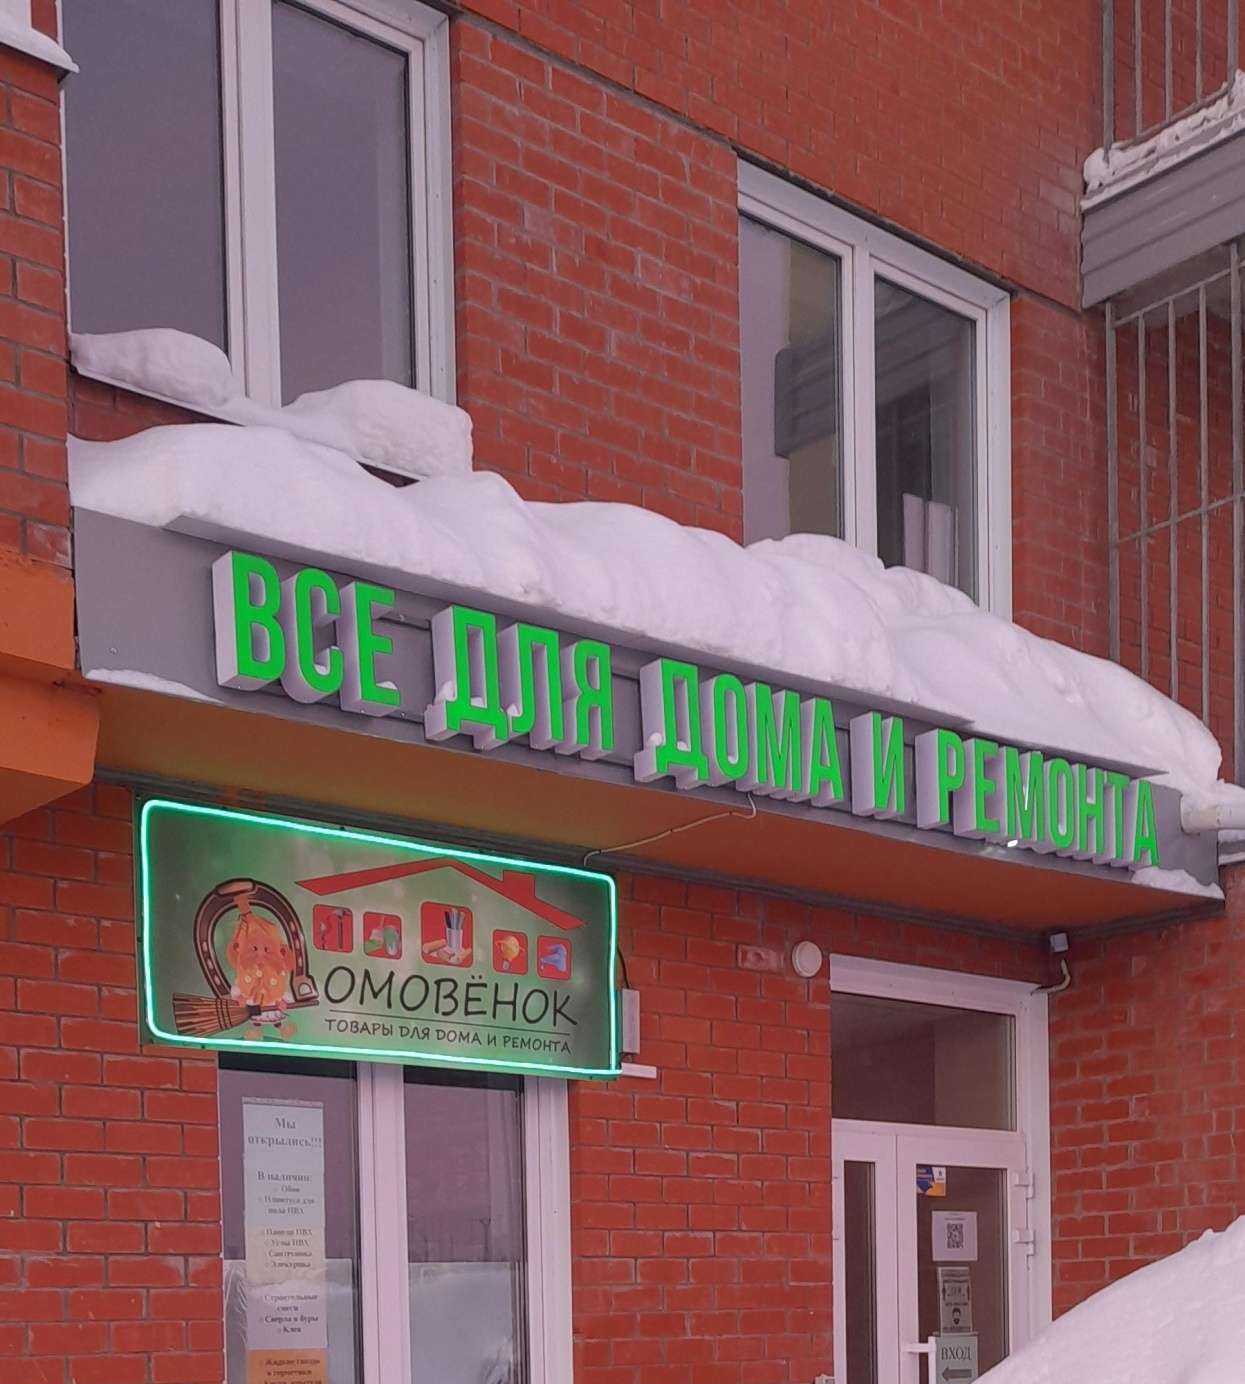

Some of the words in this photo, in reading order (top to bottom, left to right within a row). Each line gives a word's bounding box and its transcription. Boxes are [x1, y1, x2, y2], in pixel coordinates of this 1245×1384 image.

[222, 550, 400, 708] ВСЕ
[432, 604, 615, 754] ДЛЯ
[644, 656, 844, 802] ДОМА
[862, 711, 905, 818] И
[926, 728, 1162, 869] РЕМОНТА
[324, 1017, 394, 1037] ТОВАРЫ
[399, 1025, 430, 1041] ДЛЯ
[436, 1029, 482, 1046] ДОМА
[486, 1034, 497, 1048] И
[502, 1036, 573, 1055] РЕМОНТА
[273, 1117, 297, 1130] Мы
[256, 1169, 266, 1182] В
[941, 1346, 972, 1361] ВХОД
